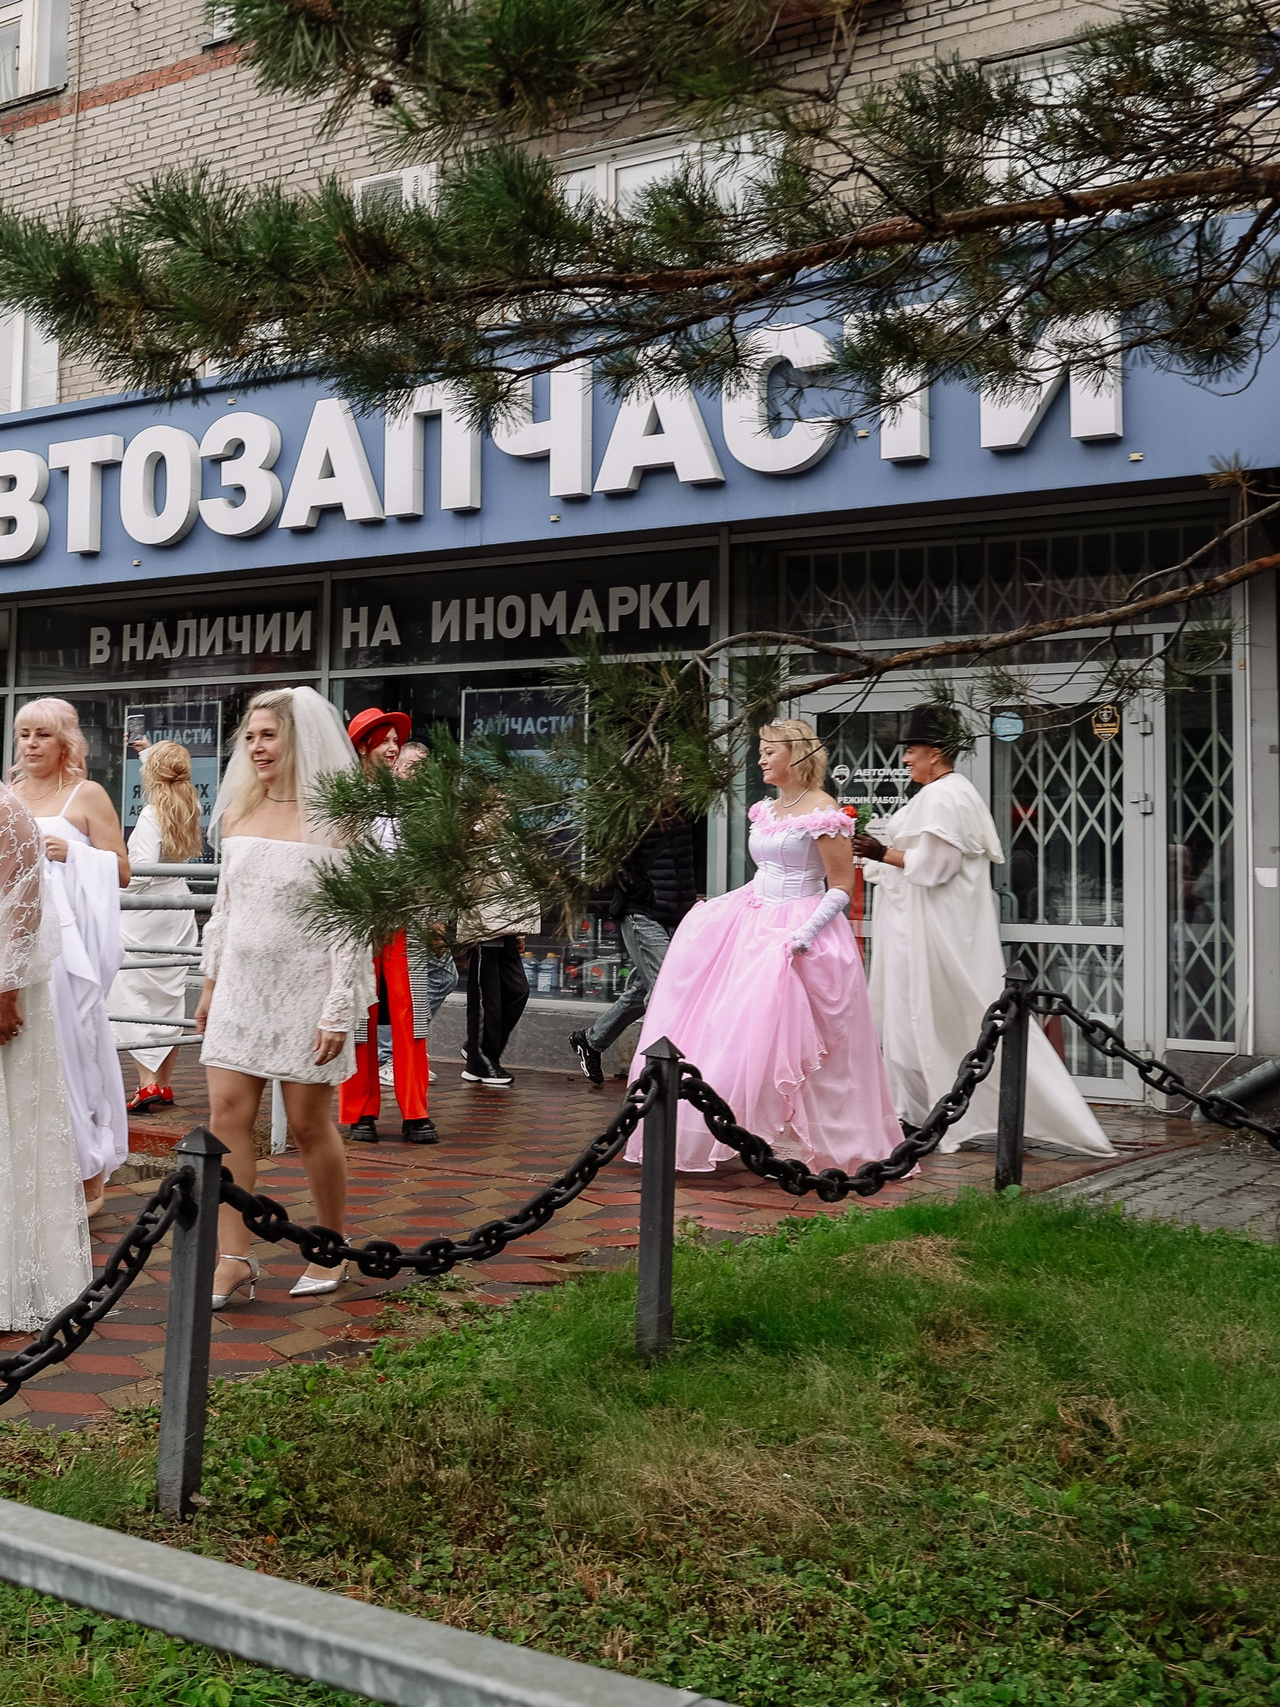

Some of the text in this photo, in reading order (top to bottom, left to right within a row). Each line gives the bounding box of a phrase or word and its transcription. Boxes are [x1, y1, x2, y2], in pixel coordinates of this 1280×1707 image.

[89, 580, 710, 664] В НАЛИЧИИ НА ИНОМАРКИ
[472, 715, 574, 737] ЗАПЧАСТИ
[144, 728, 212, 745] АПЧАСТИ
[837, 796, 909, 804] РЕЖИМ РАБОТЫ
